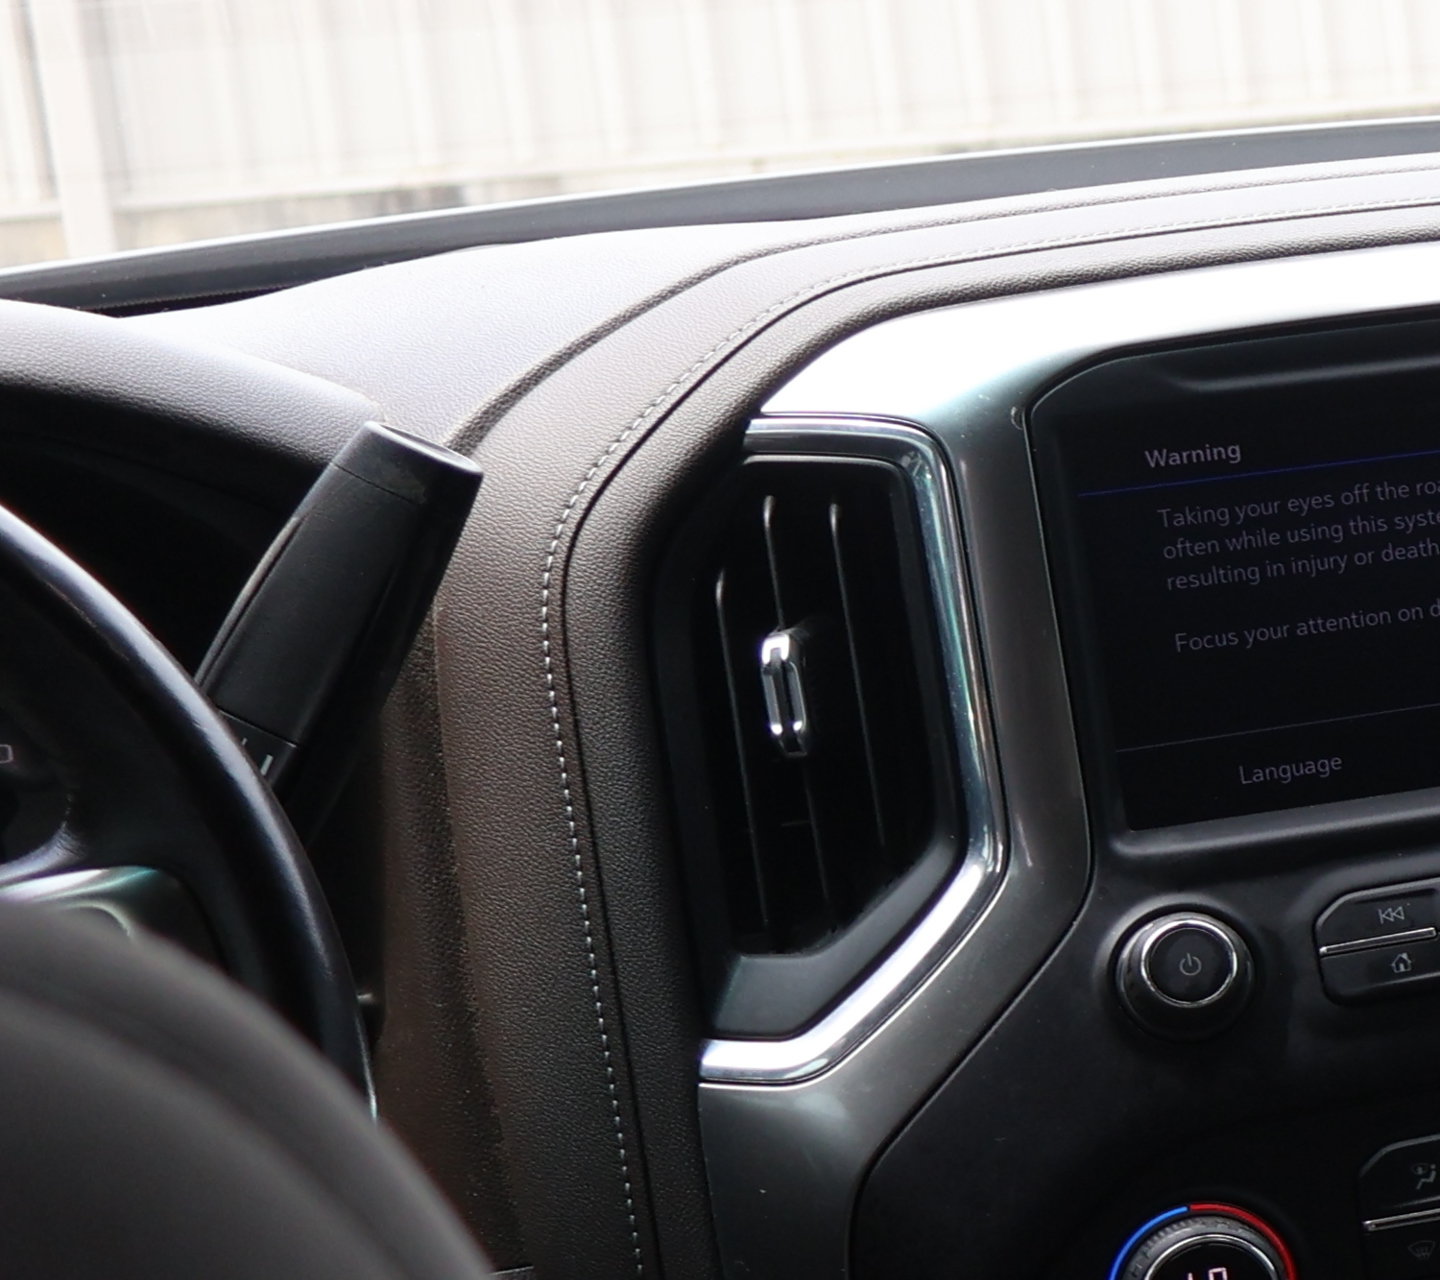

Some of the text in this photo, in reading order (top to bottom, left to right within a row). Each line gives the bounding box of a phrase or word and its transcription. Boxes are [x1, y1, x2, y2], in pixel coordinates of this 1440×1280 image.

[1145, 444, 1242, 468] Warning
[1157, 506, 1230, 528] Taking
[1235, 500, 1281, 524] your
[1288, 493, 1335, 516] eyes
[1341, 483, 1371, 505] off
[1376, 481, 1410, 501] the
[1163, 538, 1220, 560] often
[1225, 528, 1281, 551] while
[1287, 523, 1343, 543] using
[1349, 516, 1388, 536] this
[1167, 566, 1261, 590] resulting
[1266, 560, 1286, 578] in
[1291, 553, 1348, 577] injury
[1354, 549, 1375, 566] or
[1381, 538, 1440, 562] death
[1175, 632, 1240, 653] Focus
[1244, 624, 1290, 649] your
[1296, 608, 1392, 637] attention
[1398, 604, 1424, 622] on
[1238, 754, 1343, 785] Language
